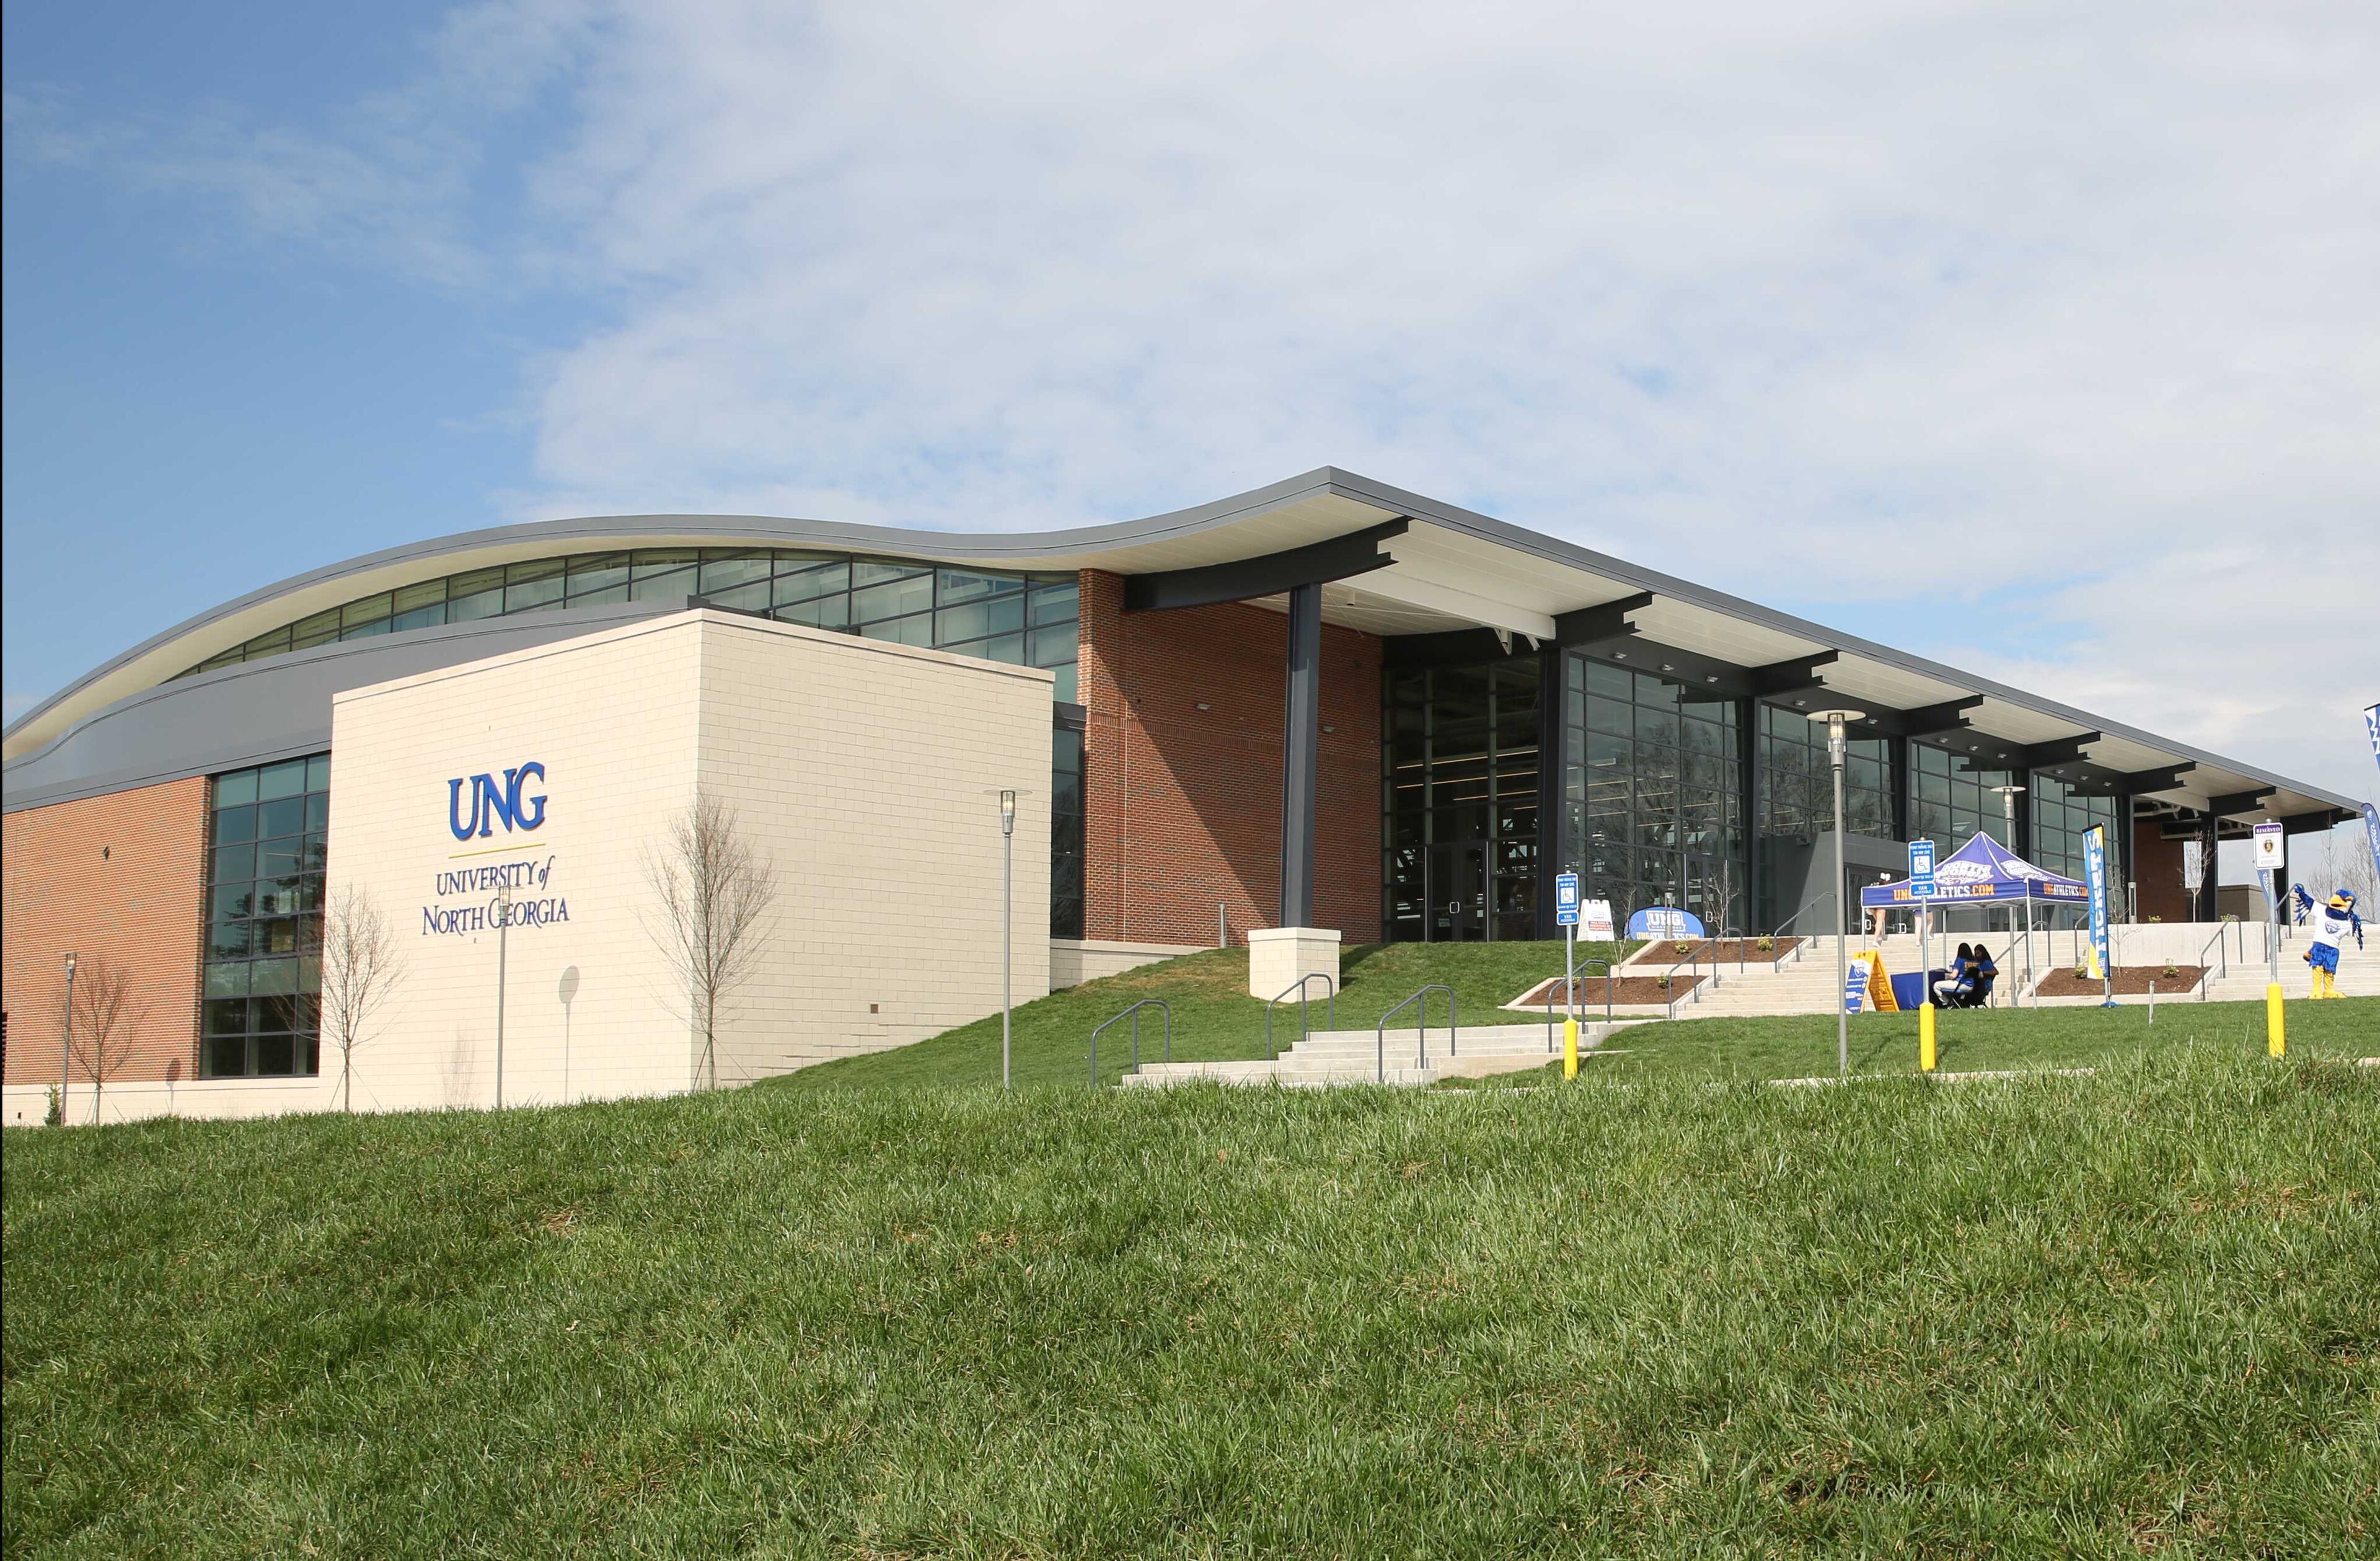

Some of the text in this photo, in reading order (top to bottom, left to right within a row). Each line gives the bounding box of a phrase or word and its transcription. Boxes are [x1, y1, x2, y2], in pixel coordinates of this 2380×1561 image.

[447, 761, 547, 841] UNG
[436, 855, 555, 896] UNIVERSITY of
[2087, 834, 2107, 958] TICKETS
[422, 905, 484, 937] NORTH
[1649, 913, 1681, 926] UNG
